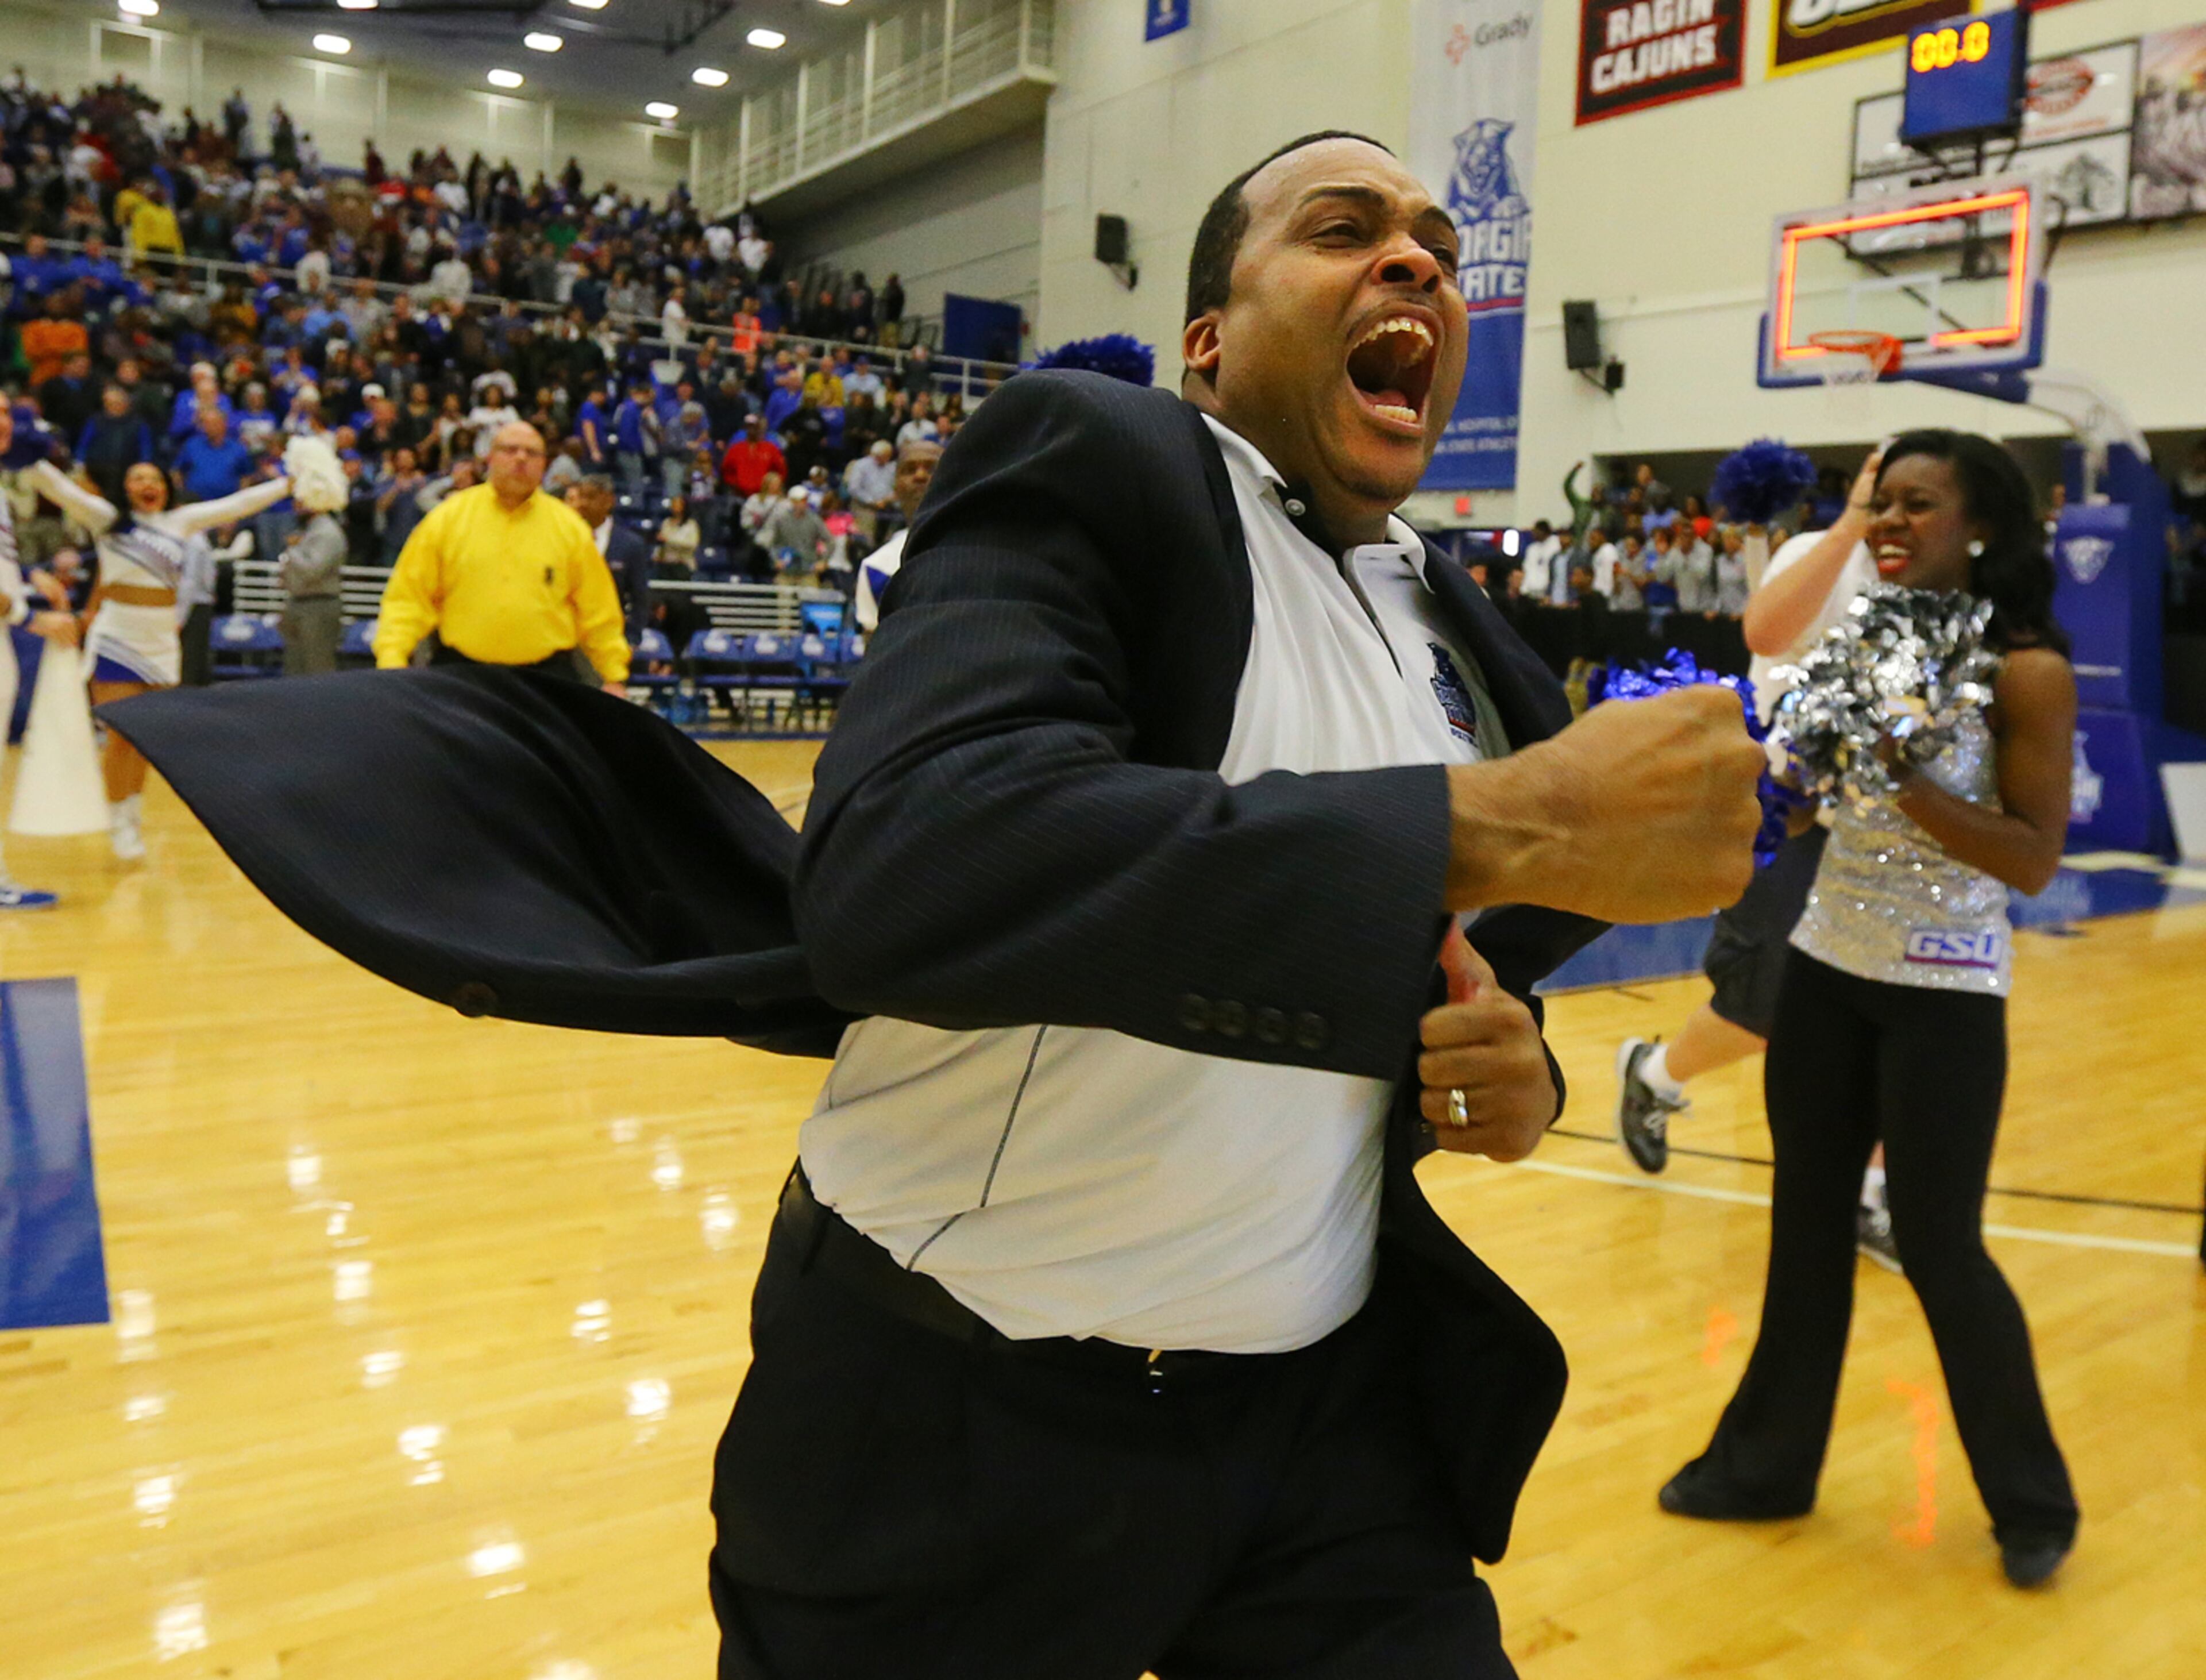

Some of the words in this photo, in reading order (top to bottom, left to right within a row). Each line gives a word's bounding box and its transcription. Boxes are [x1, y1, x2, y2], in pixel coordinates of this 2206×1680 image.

[1475, 11, 1533, 46] Grady
[1590, 23, 1717, 94] CAJUNS
[1907, 929, 2003, 965] GSU
